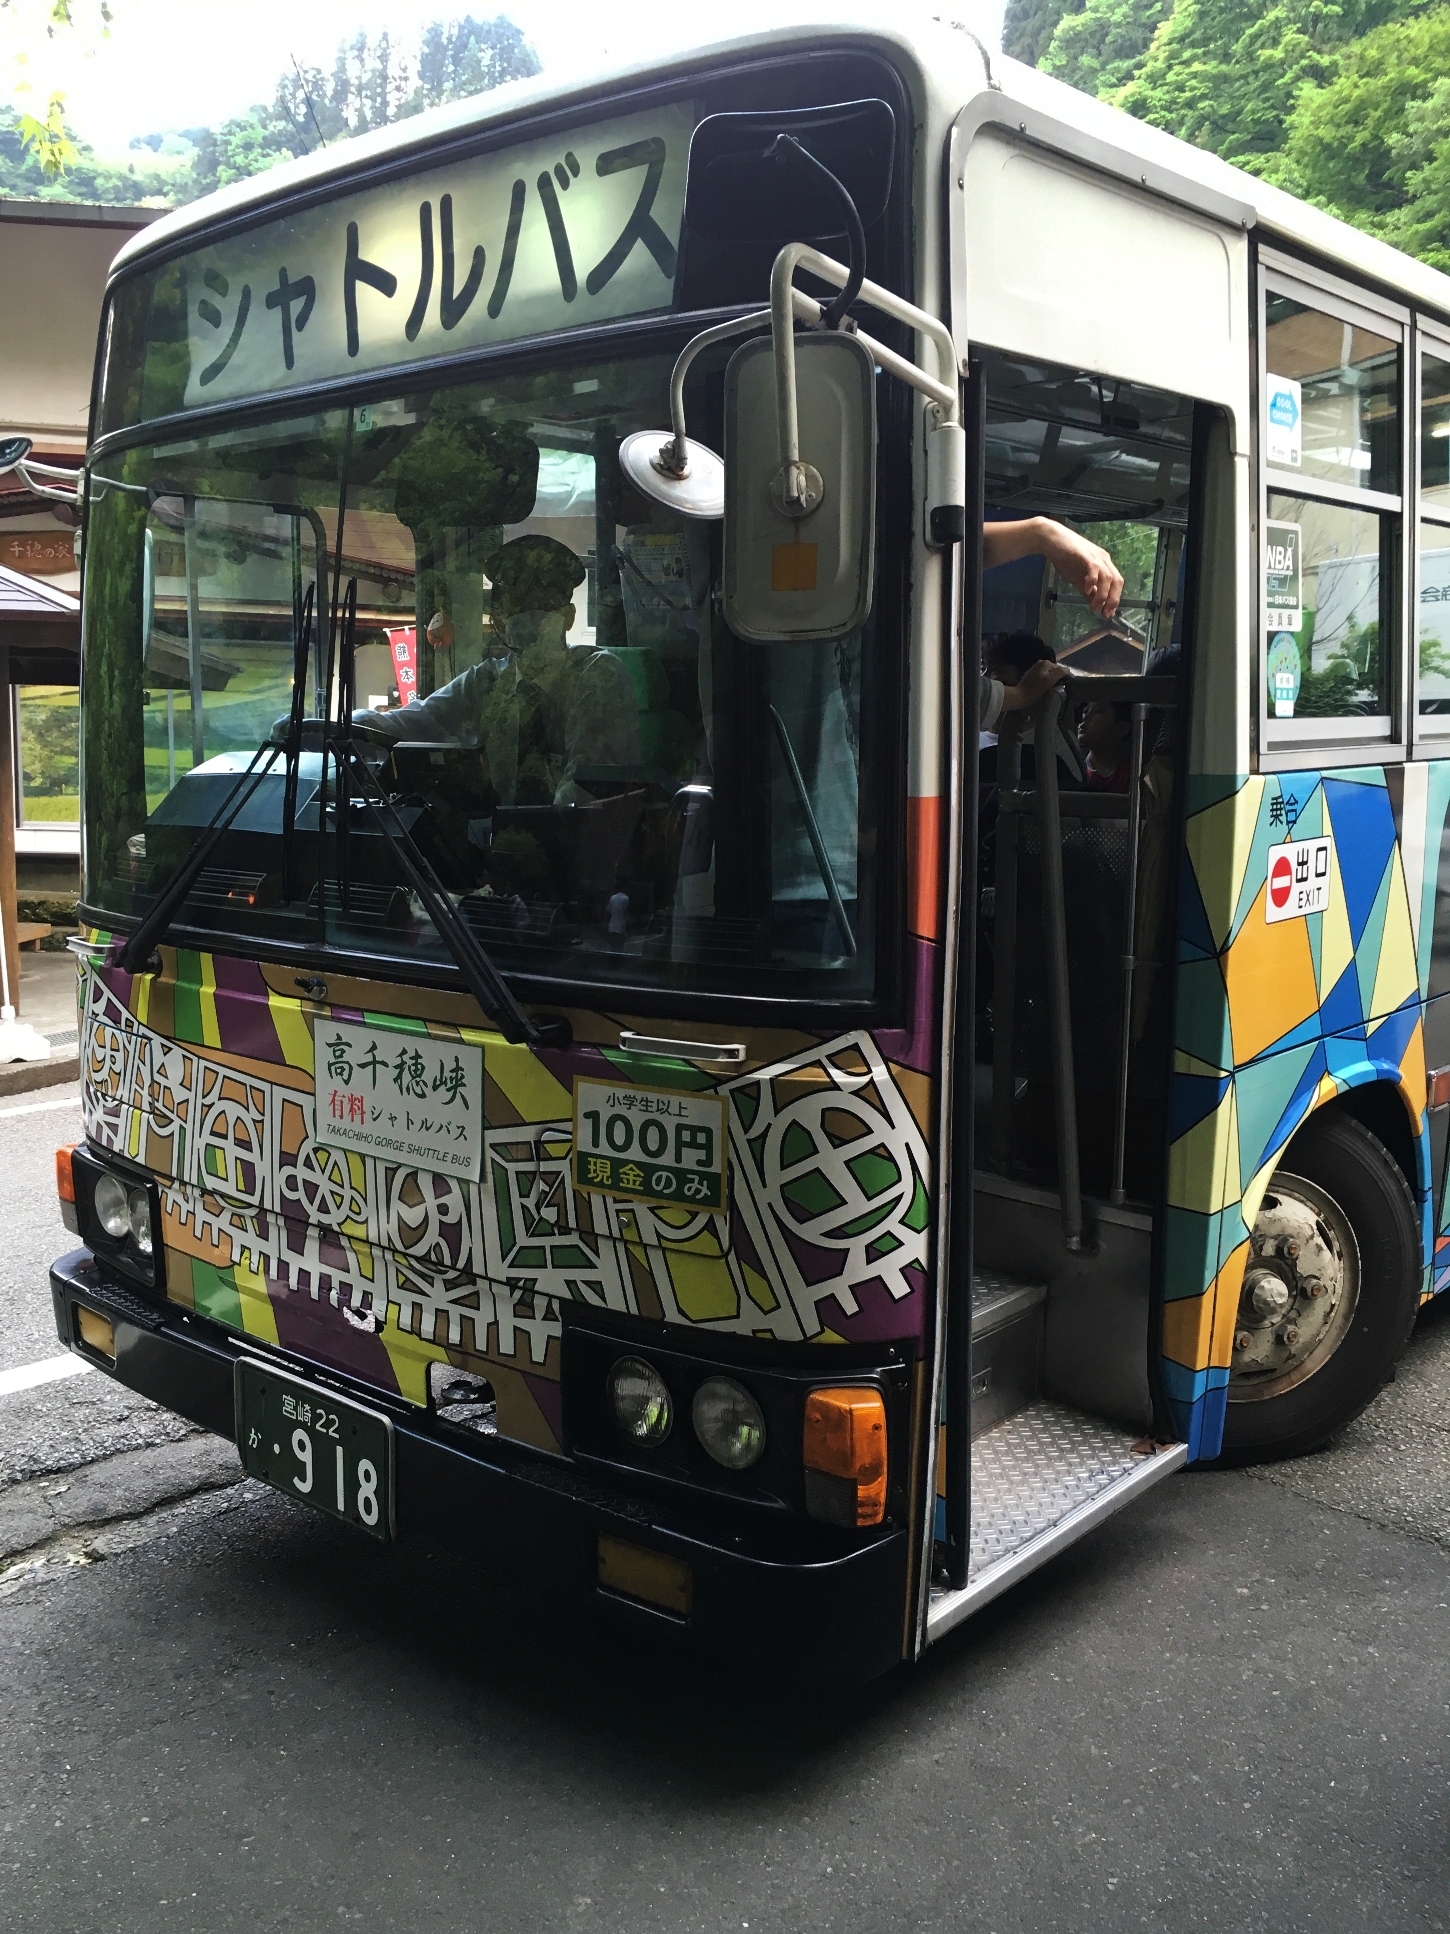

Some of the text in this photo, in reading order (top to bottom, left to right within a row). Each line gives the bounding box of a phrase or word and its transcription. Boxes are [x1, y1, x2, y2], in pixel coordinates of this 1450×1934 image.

[198, 136, 678, 387] シャトルバス
[1272, 408, 1293, 424] CHOICE
[9, 540, 71, 558] 千穂の家
[1266, 545, 1293, 570] NBA
[1269, 793, 1299, 827] 乗合
[1295, 846, 1327, 884] 出口
[1298, 887, 1322, 909] EXIT
[325, 1033, 470, 1111] 高千穂峡
[606, 1092, 689, 1118] 小学生以上
[326, 1123, 471, 1168] TAKACHIHO GORGE SHUTTLE BUS
[583, 1109, 714, 1168] 100円
[587, 1157, 711, 1199] 現金のみ
[282, 1394, 340, 1439] 宮崎 22
[249, 1428, 262, 1449] か
